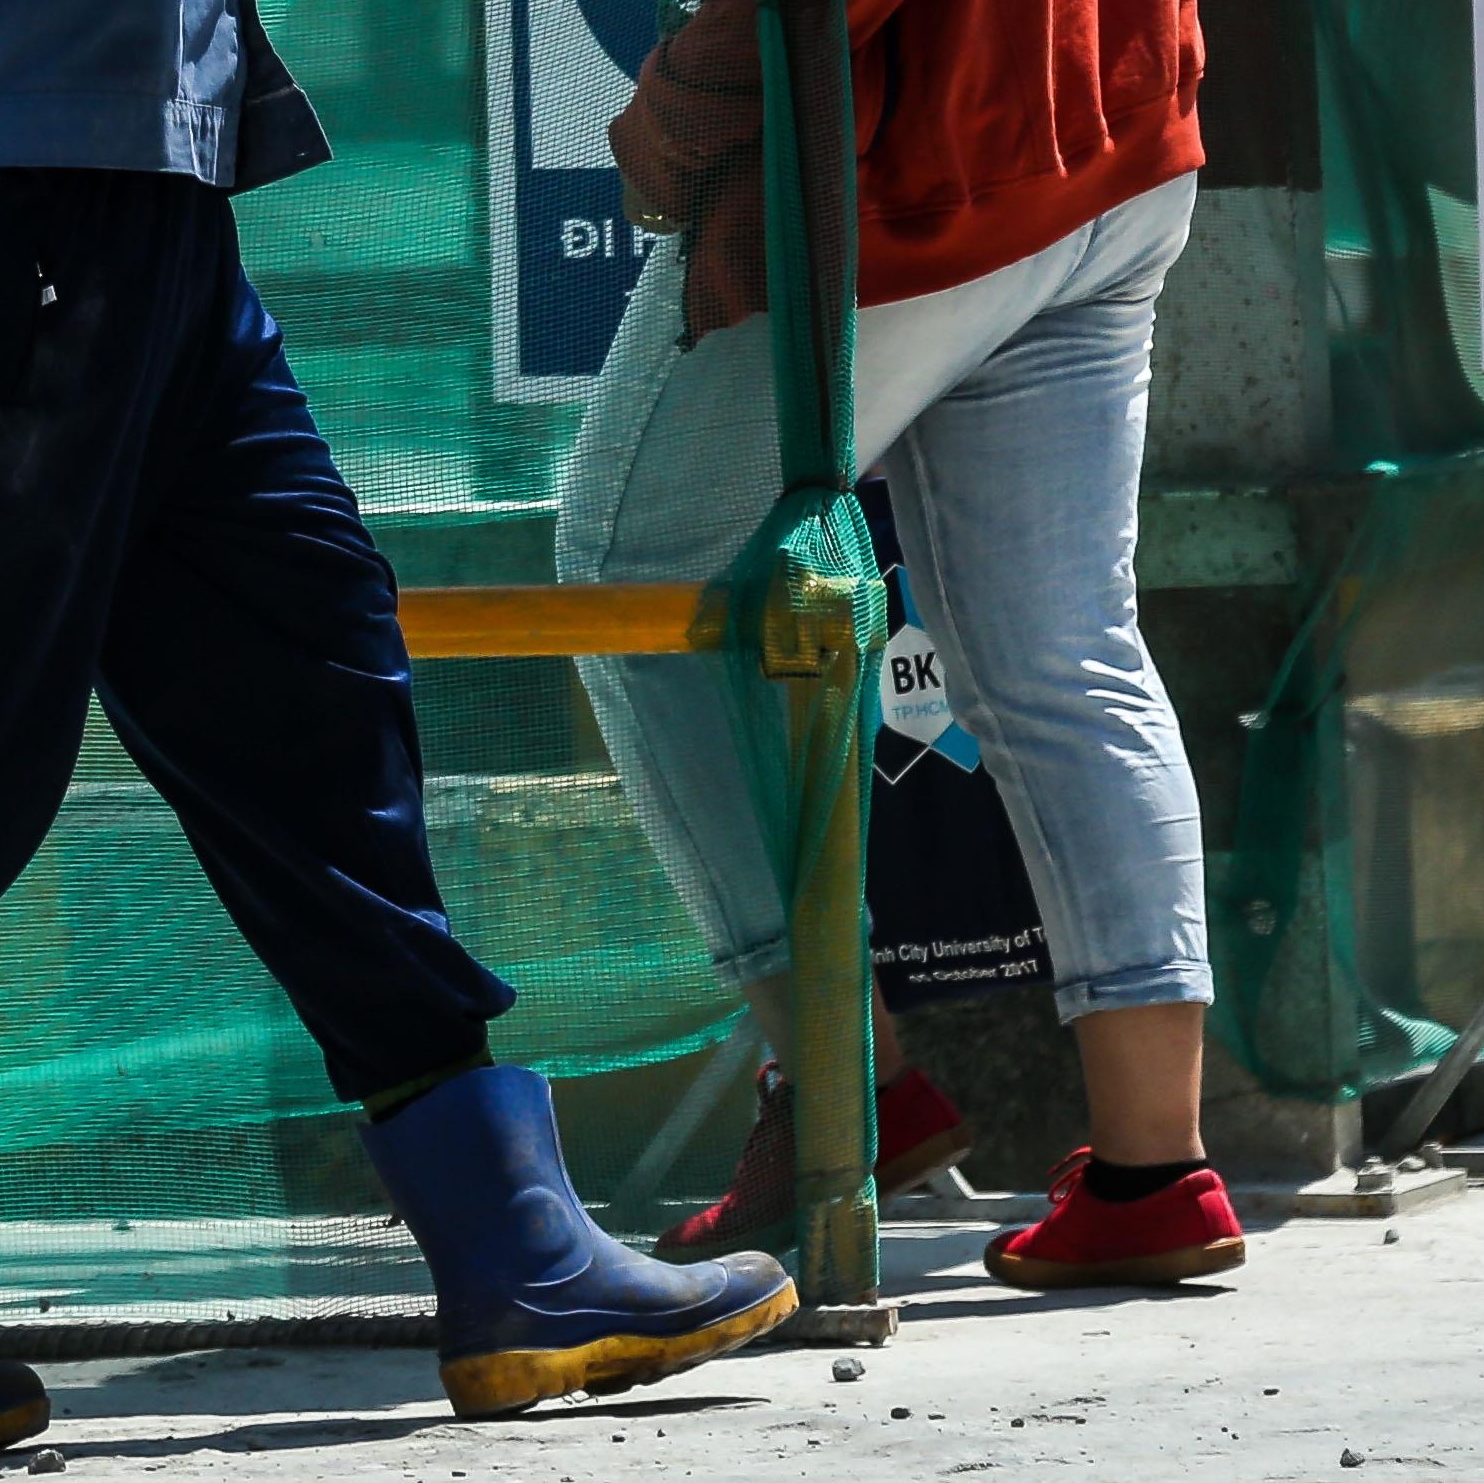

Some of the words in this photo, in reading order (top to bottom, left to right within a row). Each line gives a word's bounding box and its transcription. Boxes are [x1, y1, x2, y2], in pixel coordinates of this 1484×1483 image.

[560, 218, 615, 258] ĐI
[890, 651, 941, 695] BK
[899, 943, 928, 963] City
[932, 935, 1010, 958] University
[1014, 929, 1030, 948] of
